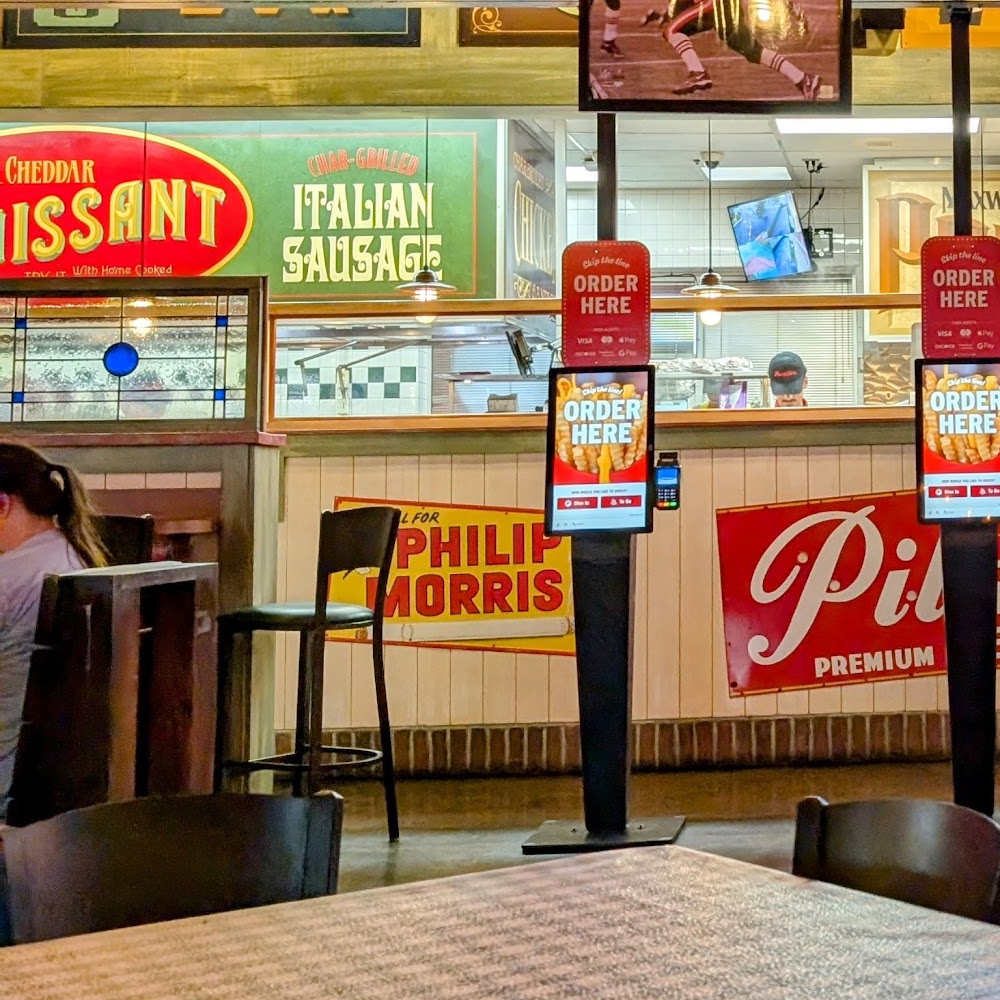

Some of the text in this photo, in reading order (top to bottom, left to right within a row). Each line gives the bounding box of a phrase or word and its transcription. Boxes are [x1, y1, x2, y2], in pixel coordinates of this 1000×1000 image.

[4, 155, 96, 185] CHEDDAR
[306, 147, 421, 177] CHAR-GRILLED
[292, 182, 435, 231] ITALIAN
[281, 234, 445, 284] SAUSAGE
[583, 256, 631, 270] Skip the line
[941, 251, 987, 264] Skip the line
[72, 264, 99, 276] With
[101, 265, 131, 276] Home
[932, 268, 995, 287] ORDER
[573, 274, 639, 293] ORDER
[581, 296, 632, 315] HERE
[940, 290, 989, 308] HERE
[577, 337, 593, 345] VISA
[563, 398, 641, 422] ORDER
[571, 422, 632, 445] HERE
[938, 413, 998, 435] HERE
[411, 511, 440, 524] FOR
[396, 522, 563, 569] PHILIP
[365, 568, 564, 618] MORRIS
[814, 645, 935, 678] PREMIUM
